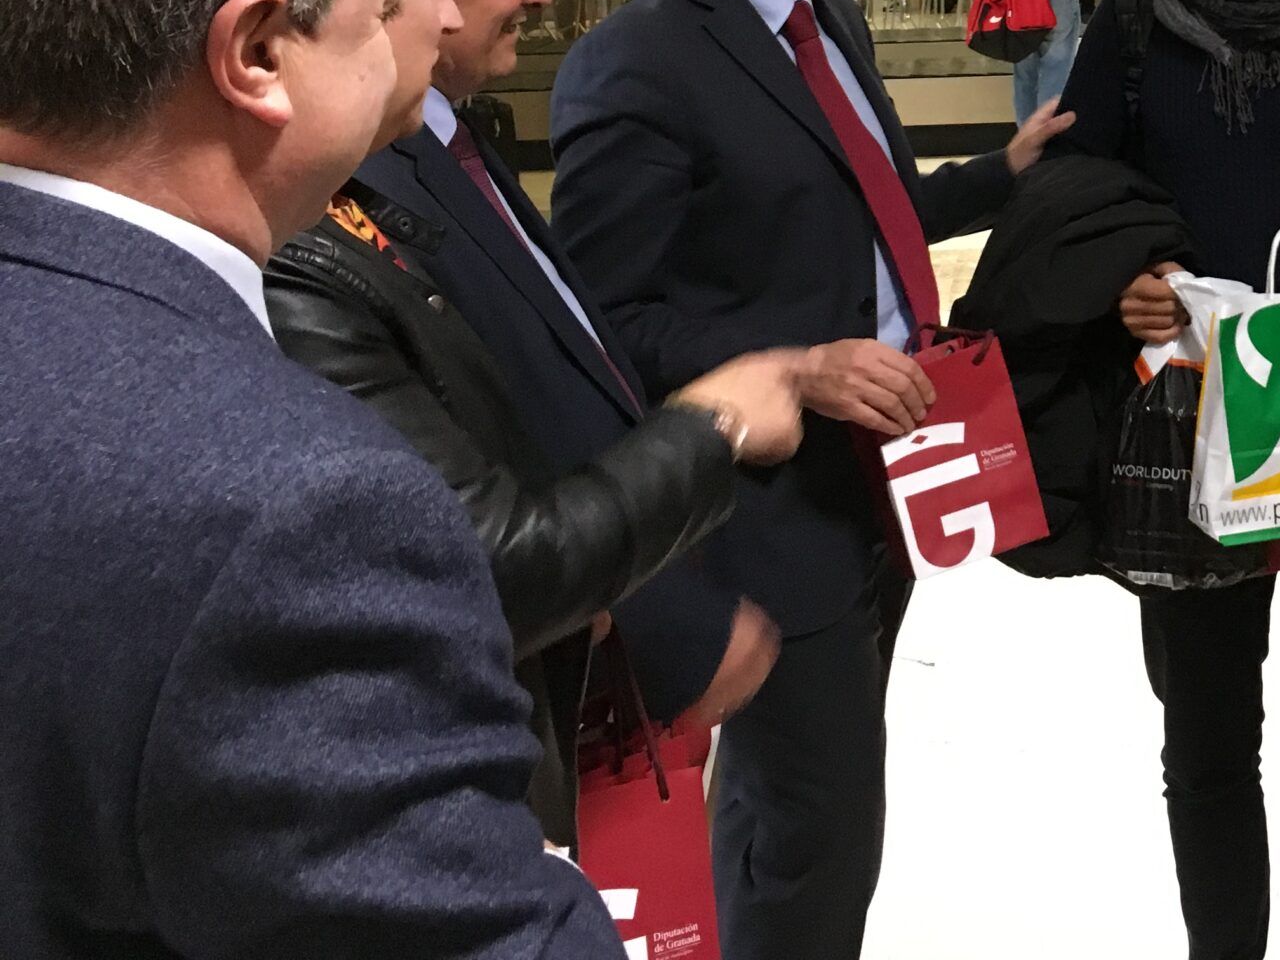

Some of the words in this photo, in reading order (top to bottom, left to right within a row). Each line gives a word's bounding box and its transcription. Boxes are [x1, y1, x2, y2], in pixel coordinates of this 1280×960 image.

[653, 923, 698, 942] Diputación
[654, 944, 665, 953] de
[666, 933, 701, 948] Granada
